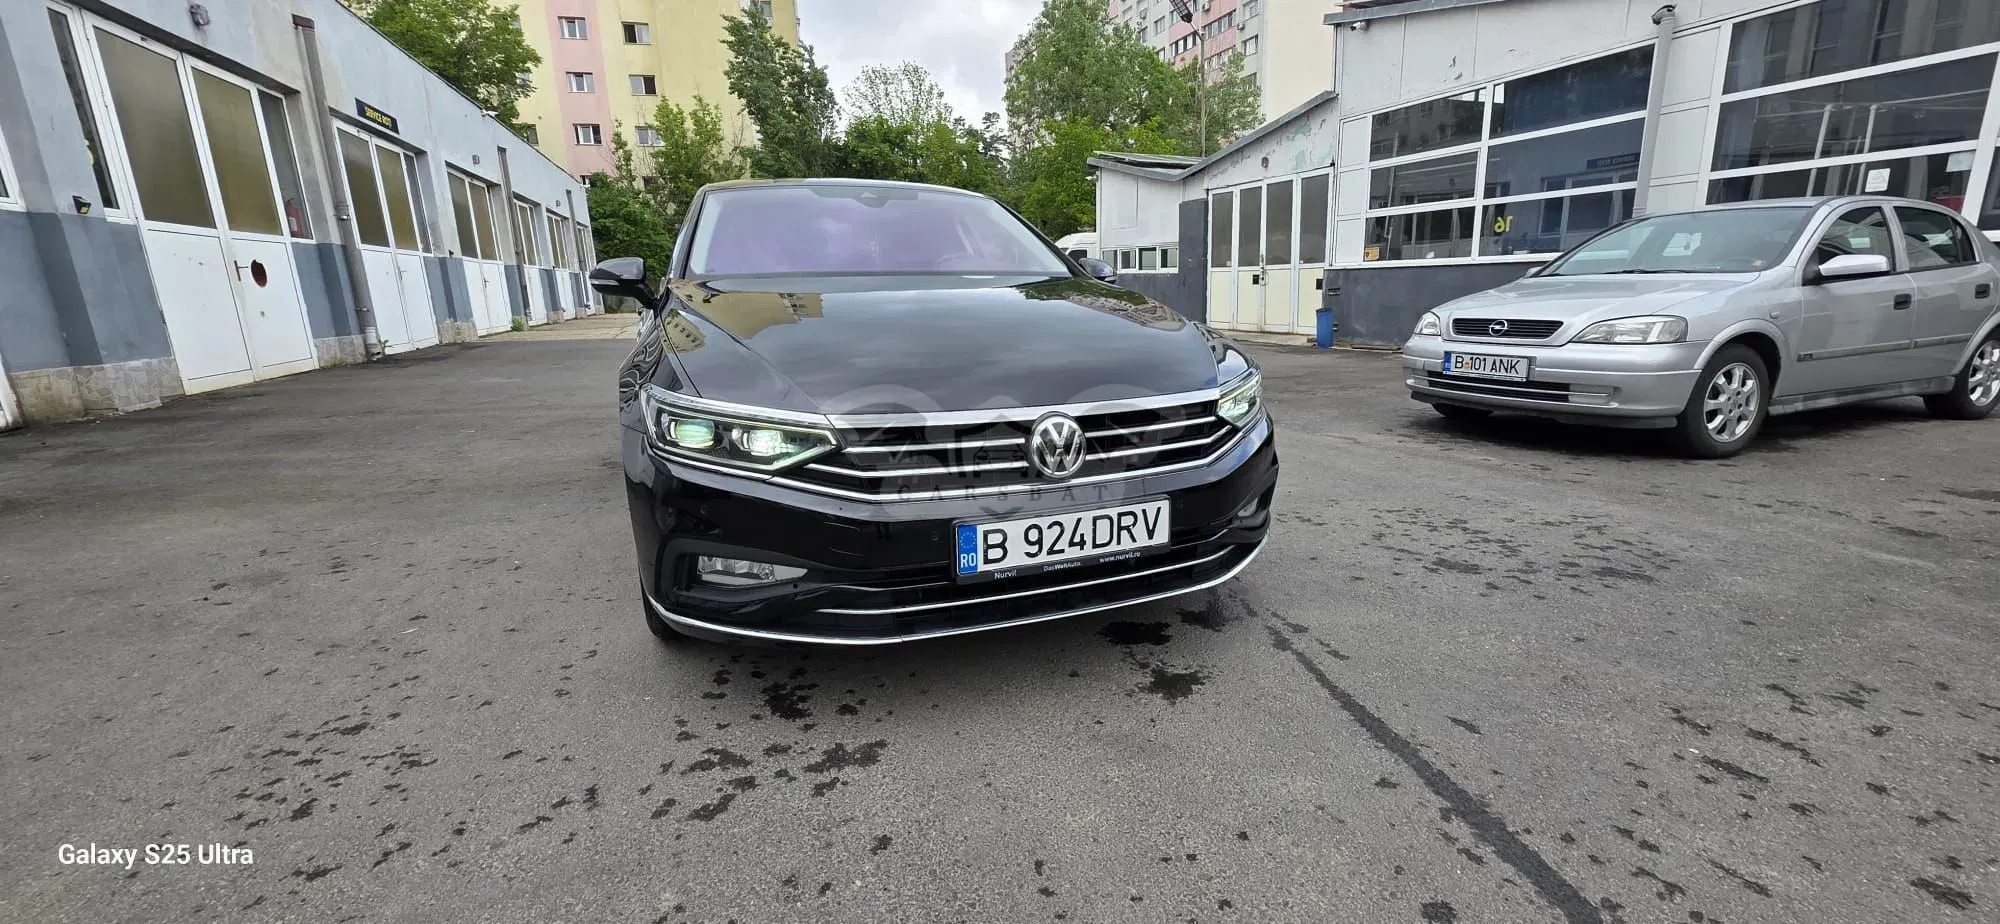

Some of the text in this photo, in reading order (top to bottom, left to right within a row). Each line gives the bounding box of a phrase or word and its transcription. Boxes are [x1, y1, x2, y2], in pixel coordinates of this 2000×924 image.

[1454, 355, 1465, 369] B
[1469, 356, 1487, 371] 101
[1490, 358, 1520, 375] ANK
[983, 506, 1162, 565] B 924DRV
[961, 552, 976, 568] RO
[994, 569, 1017, 580] Nurvil
[1099, 551, 1141, 563] www.nurvil.ro
